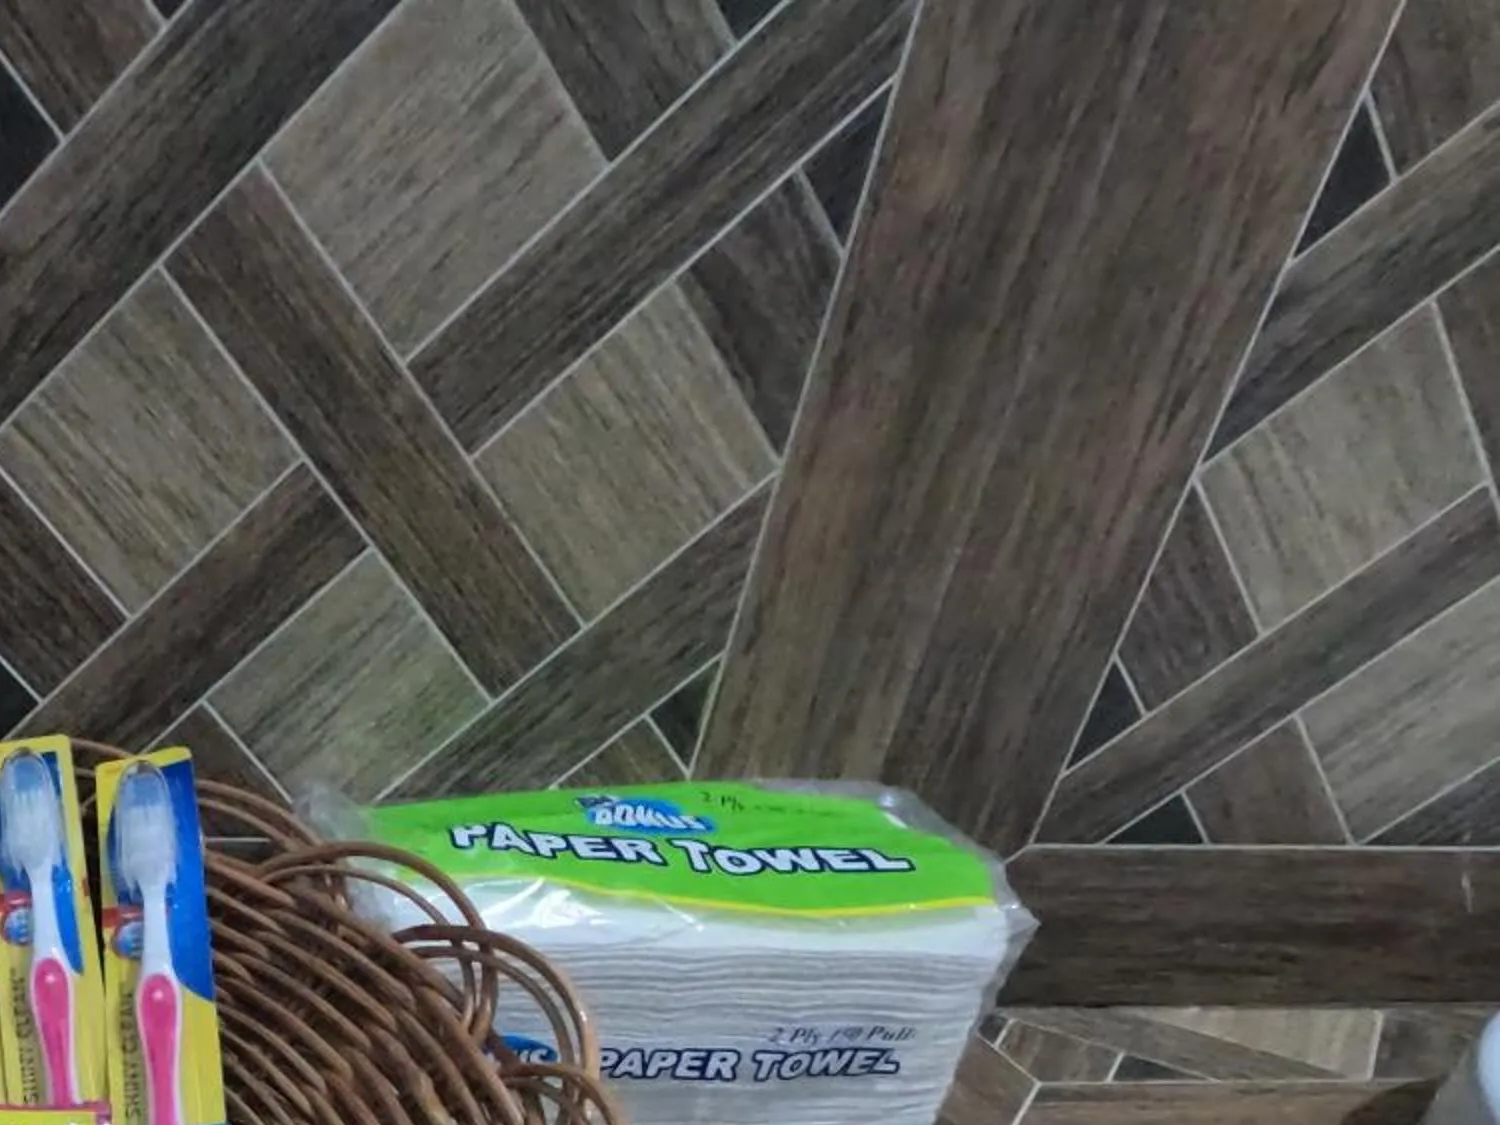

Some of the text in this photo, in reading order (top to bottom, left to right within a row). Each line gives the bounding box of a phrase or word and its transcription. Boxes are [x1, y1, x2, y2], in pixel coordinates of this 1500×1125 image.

[448, 823, 916, 875] PAPER TOWEL
[600, 1047, 900, 1082] PAPER TOWEL
